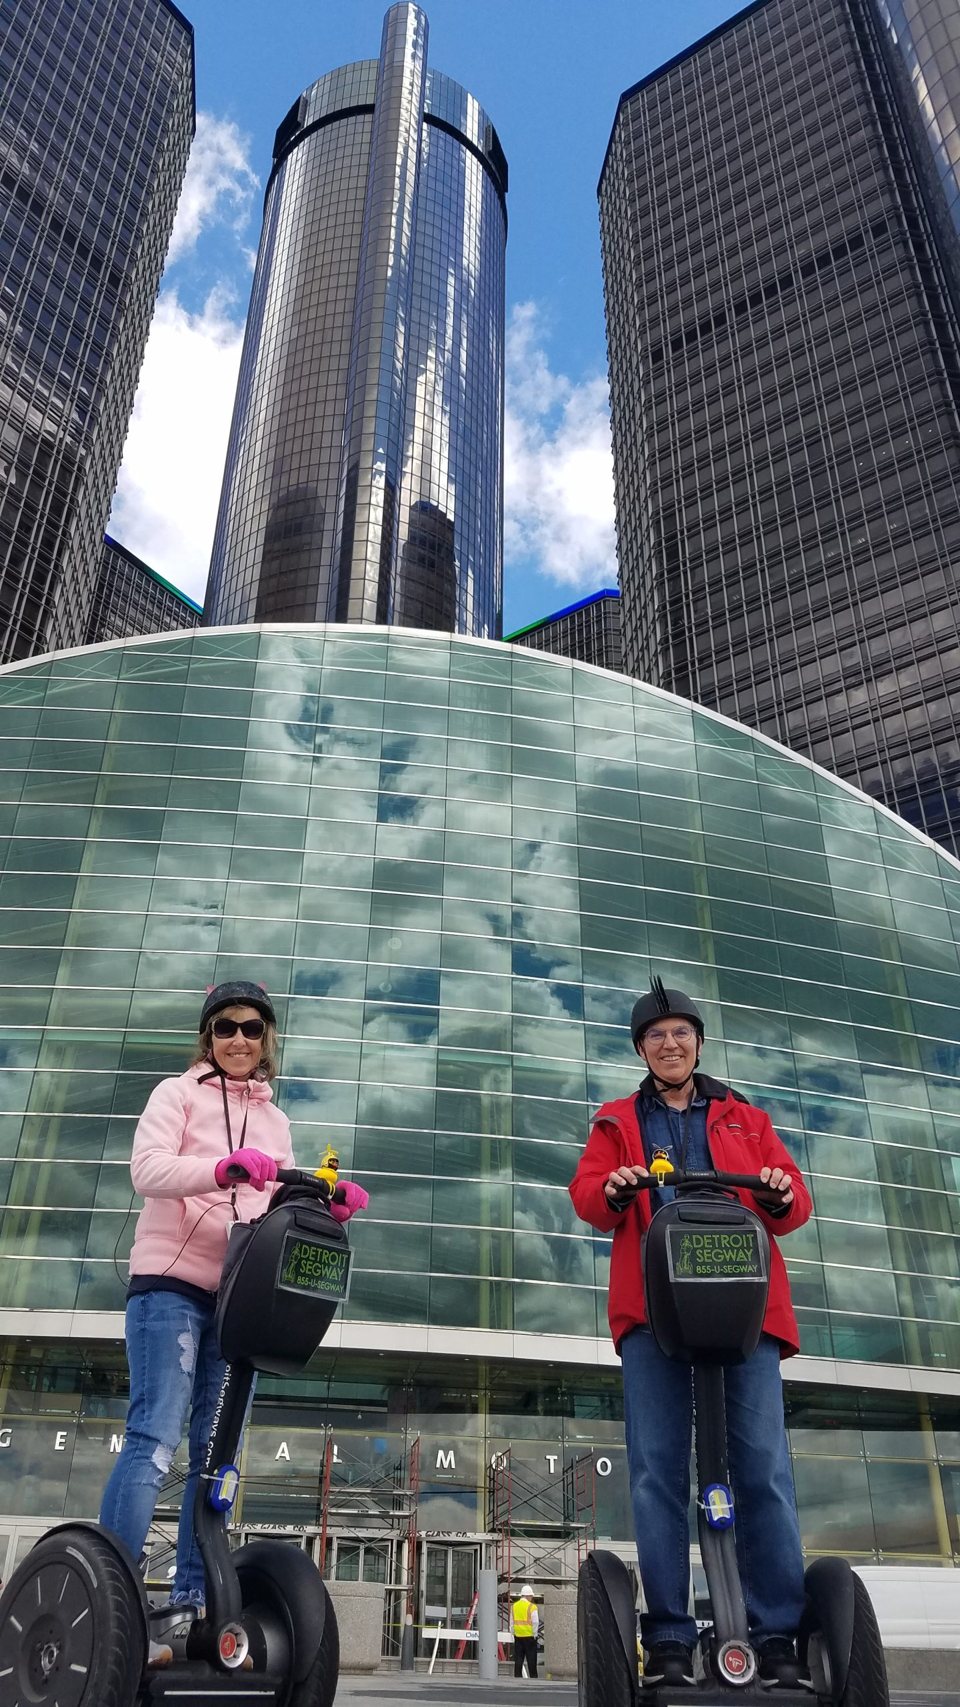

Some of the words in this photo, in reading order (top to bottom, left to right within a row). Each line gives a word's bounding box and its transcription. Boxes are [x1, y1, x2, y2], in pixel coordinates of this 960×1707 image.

[693, 1234, 754, 1248] DETROIT
[300, 1244, 348, 1267] DETROIT
[696, 1248, 753, 1262] SEGWAY
[300, 1261, 345, 1281] SEGWAY
[696, 1264, 758, 1274] 855-U-SEGWAY
[297, 1276, 344, 1293] 855-U-SEGWAY
[435, 1450, 612, 1477] MOTO
